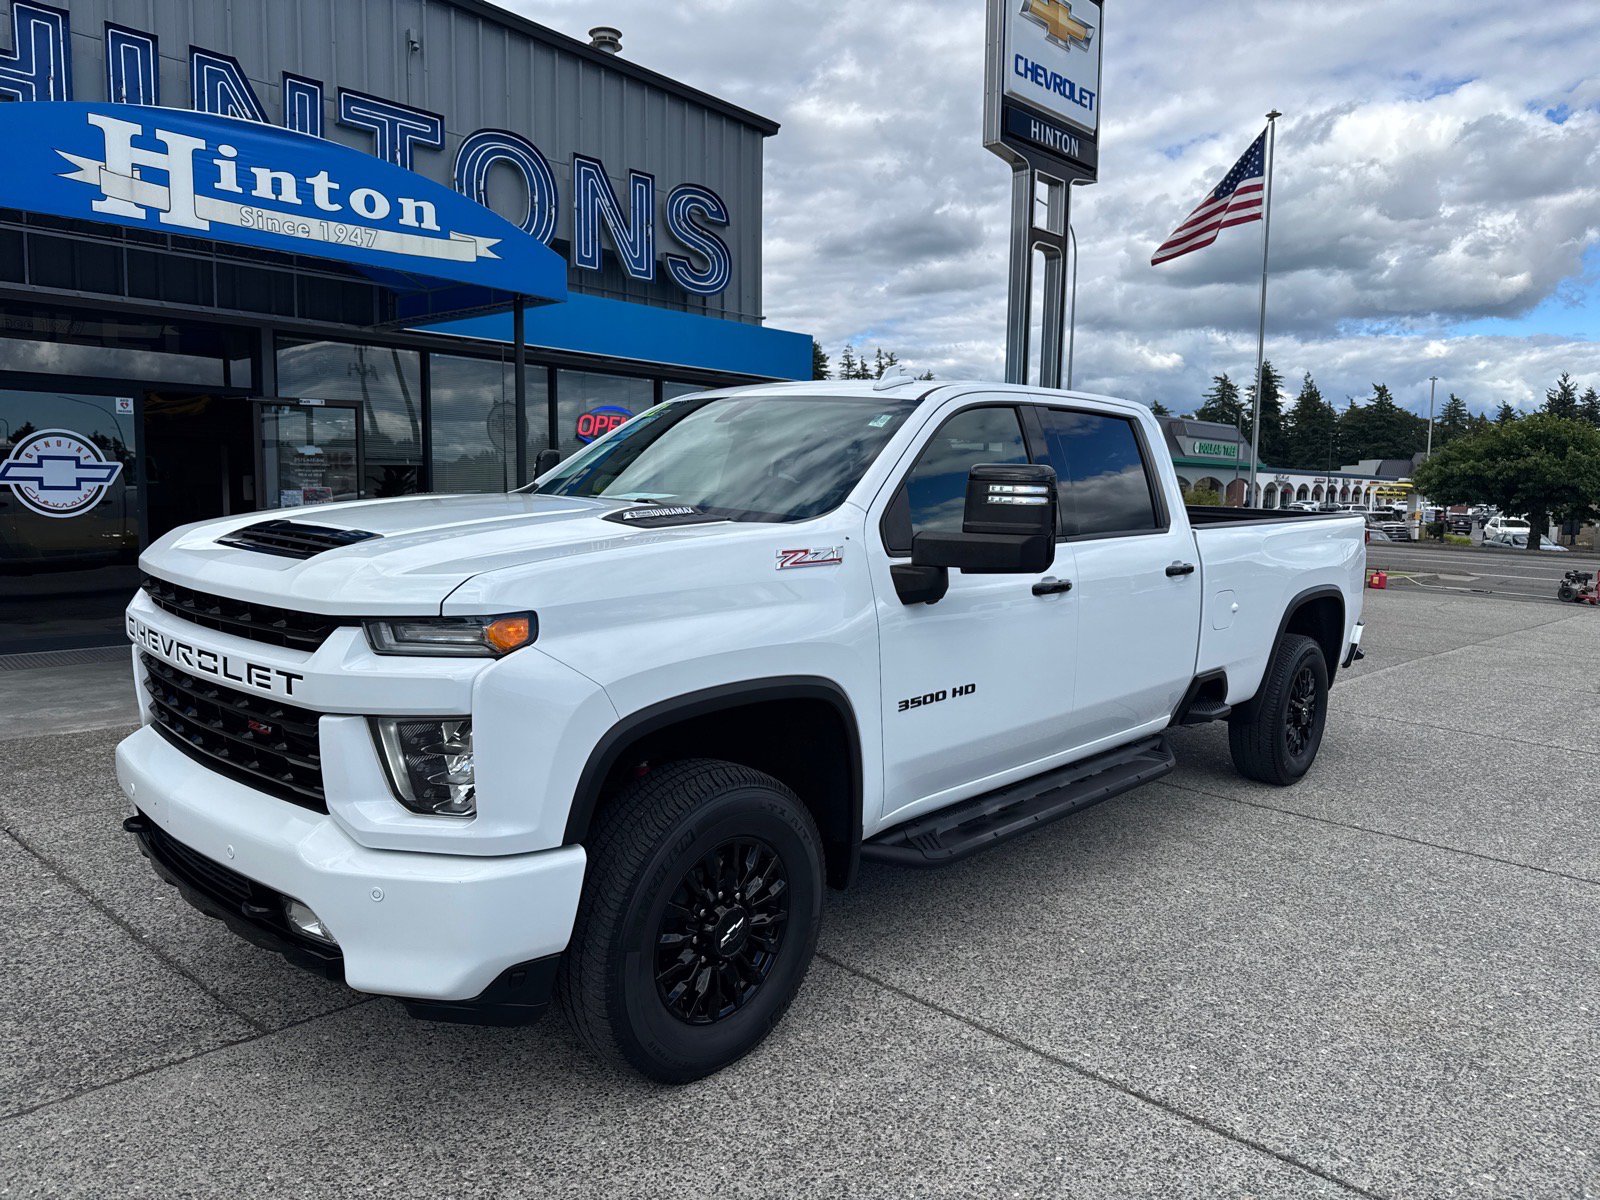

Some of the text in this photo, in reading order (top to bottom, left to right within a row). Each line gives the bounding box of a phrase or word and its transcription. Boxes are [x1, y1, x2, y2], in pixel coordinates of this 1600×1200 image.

[1014, 53, 1096, 111] CHEVROLET
[1030, 119, 1079, 158] HINTON
[87, 112, 441, 231] Hinton
[240, 206, 378, 248] Since 1947
[577, 413, 629, 437] OPE
[25, 439, 91, 461] GENUINE
[1200, 442, 1236, 457] DOLLAR TREE
[24, 486, 97, 508] Chevrolet
[654, 506, 695, 517] DURAMAX
[775, 546, 844, 570] Z71
[128, 616, 304, 696] CHEVROLET
[898, 683, 976, 712] 3500 HD
